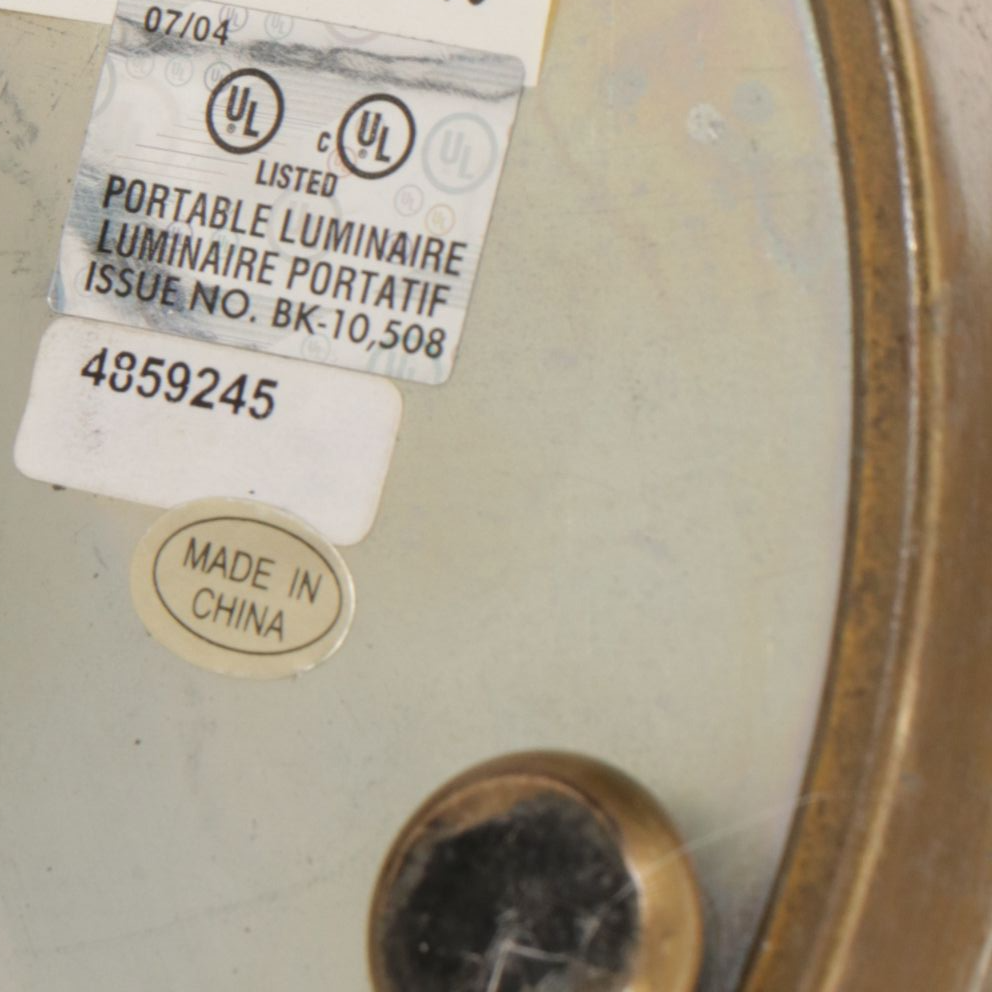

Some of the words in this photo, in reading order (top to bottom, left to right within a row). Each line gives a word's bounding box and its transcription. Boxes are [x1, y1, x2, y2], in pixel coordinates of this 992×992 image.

[143, 5, 231, 46] 07/04
[225, 84, 260, 138] UL
[357, 109, 392, 164] UL
[255, 158, 339, 198] LISTED
[102, 174, 273, 239] PORTABLE
[278, 209, 468, 277] LUMINAIRE
[96, 219, 280, 285] LUMINAIRE
[285, 256, 452, 318] PORTATIF
[84, 260, 181, 307] ISSUE
[189, 279, 257, 323] NO.
[270, 297, 447, 359] BK-10,508
[80, 347, 279, 421] 4859245
[182, 536, 277, 591] MADE
[287, 566, 323, 605] IN
[191, 586, 285, 643] CHINA
